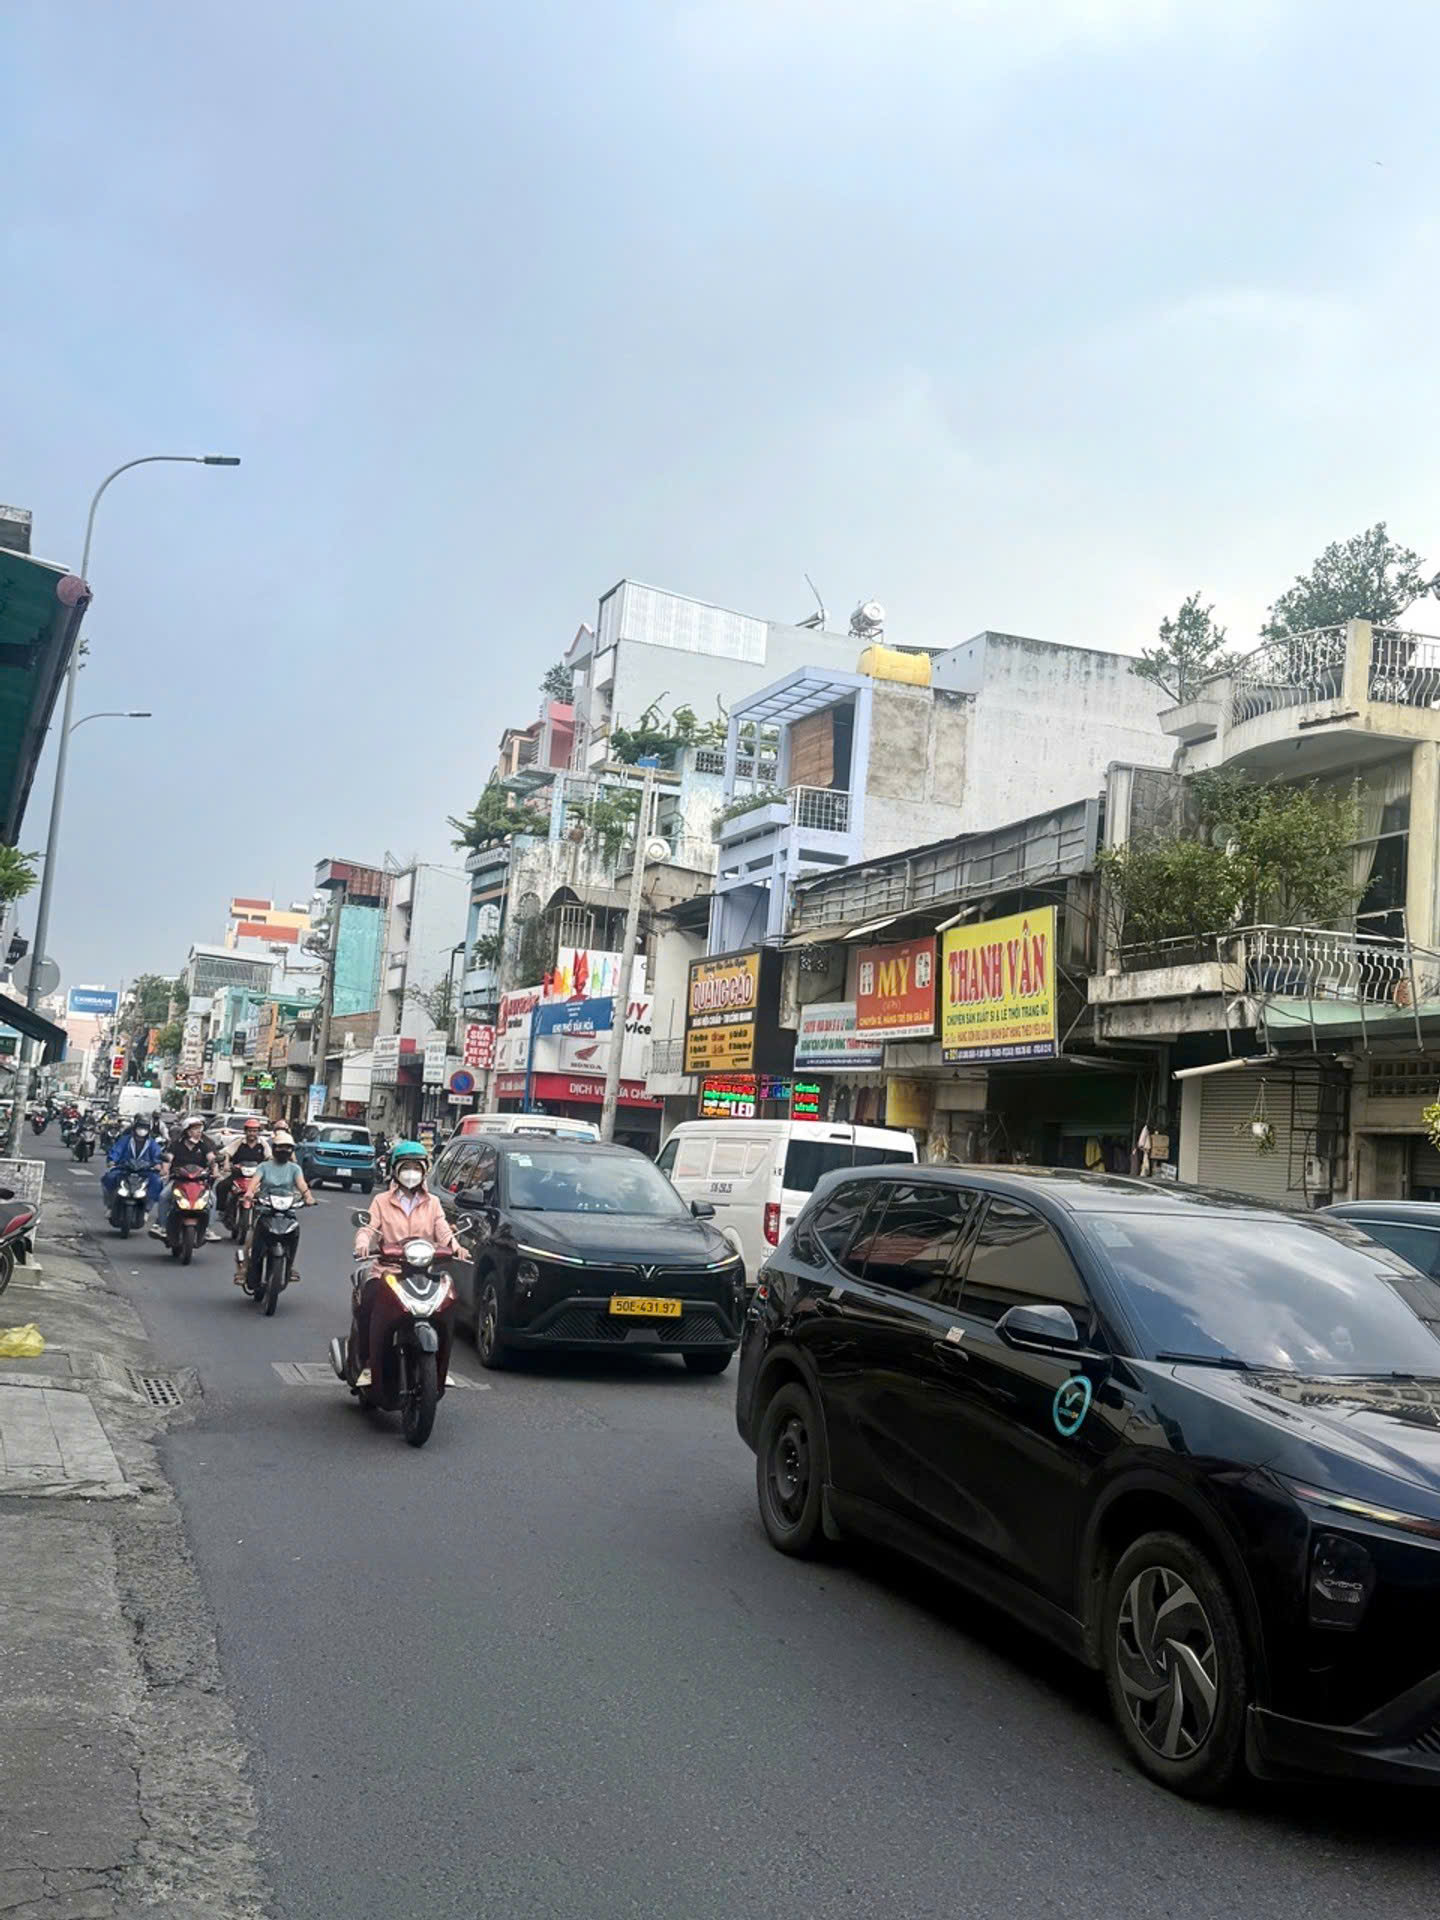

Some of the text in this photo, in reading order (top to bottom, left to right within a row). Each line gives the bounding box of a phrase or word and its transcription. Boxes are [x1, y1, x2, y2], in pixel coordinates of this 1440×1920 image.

[949, 919, 1047, 1005] THANH VÂN
[877, 948, 910, 998] MỸ
[570, 1062, 602, 1070] HONDA
[569, 1083, 592, 1097] DỊCH
[730, 1101, 755, 1117] LED
